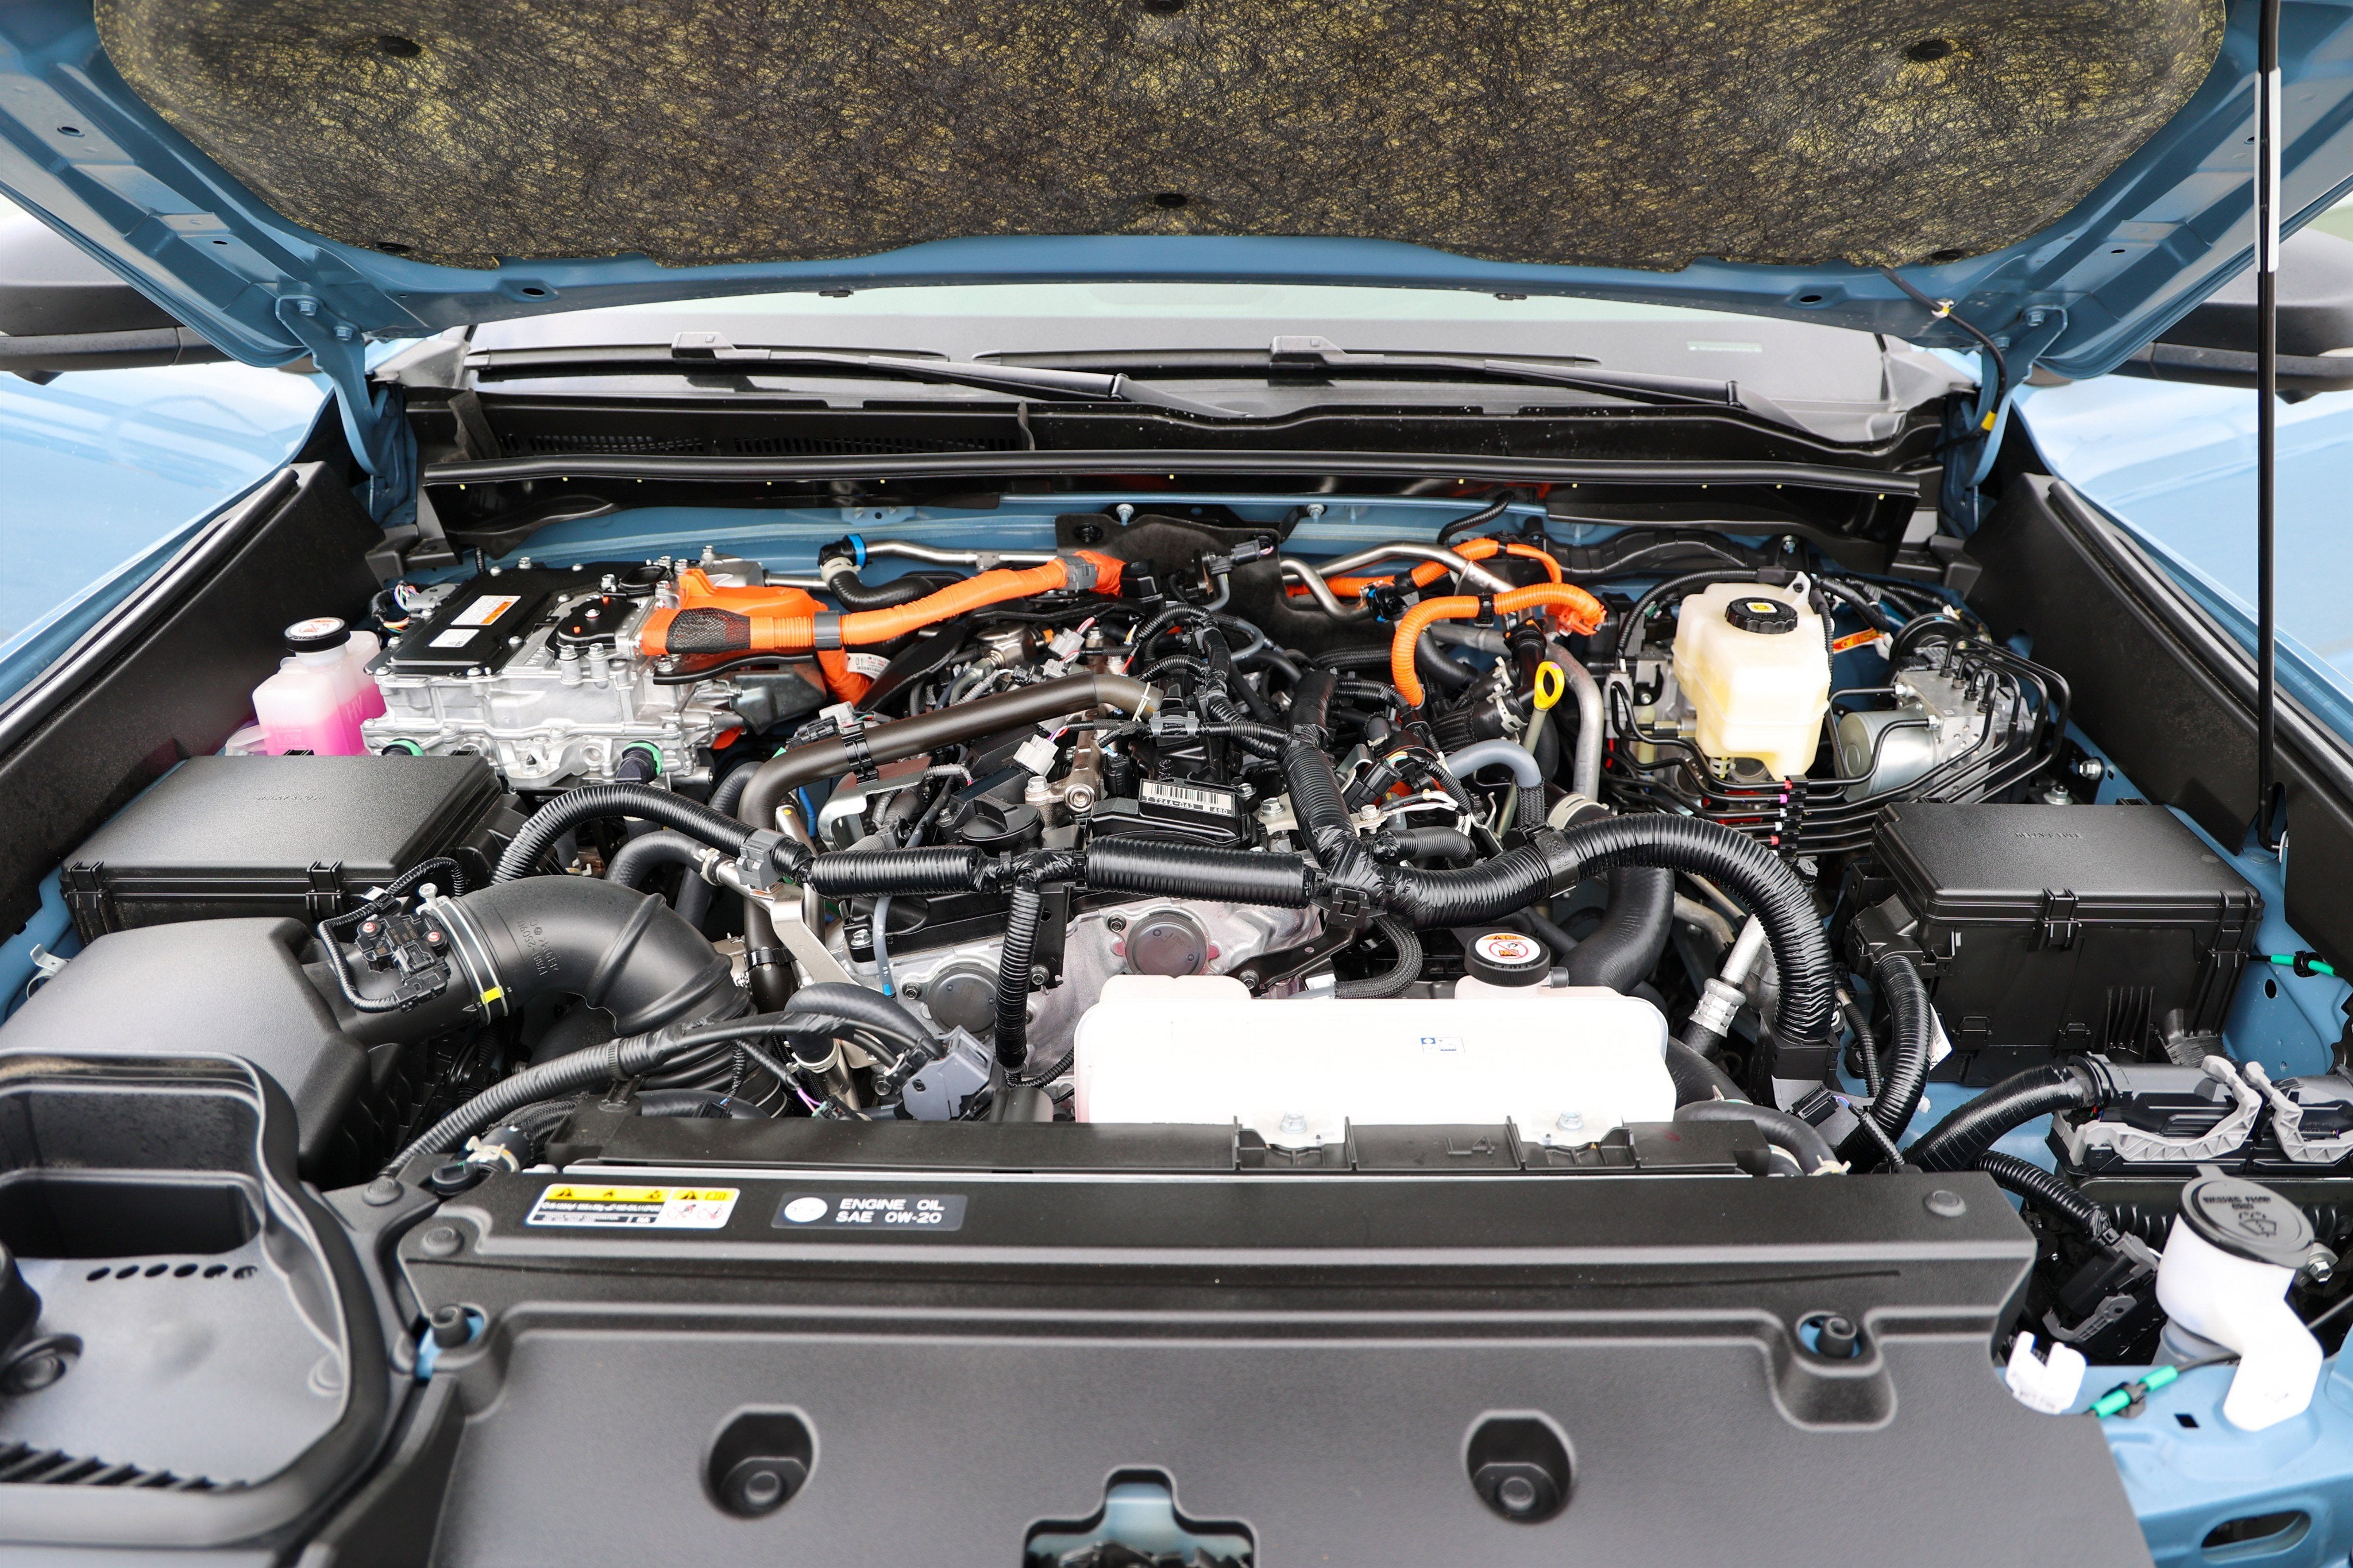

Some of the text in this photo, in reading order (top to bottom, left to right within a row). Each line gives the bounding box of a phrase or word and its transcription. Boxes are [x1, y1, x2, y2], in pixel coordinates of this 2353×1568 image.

[276, 733, 302, 744] LOW
[1154, 797, 1194, 809] T24A-G43
[1545, 838, 1563, 855] 28
[517, 920, 548, 975] 17881-25090
[839, 1198, 946, 1211] ENGINE OIL
[836, 1211, 942, 1223] SAE 0W-20
